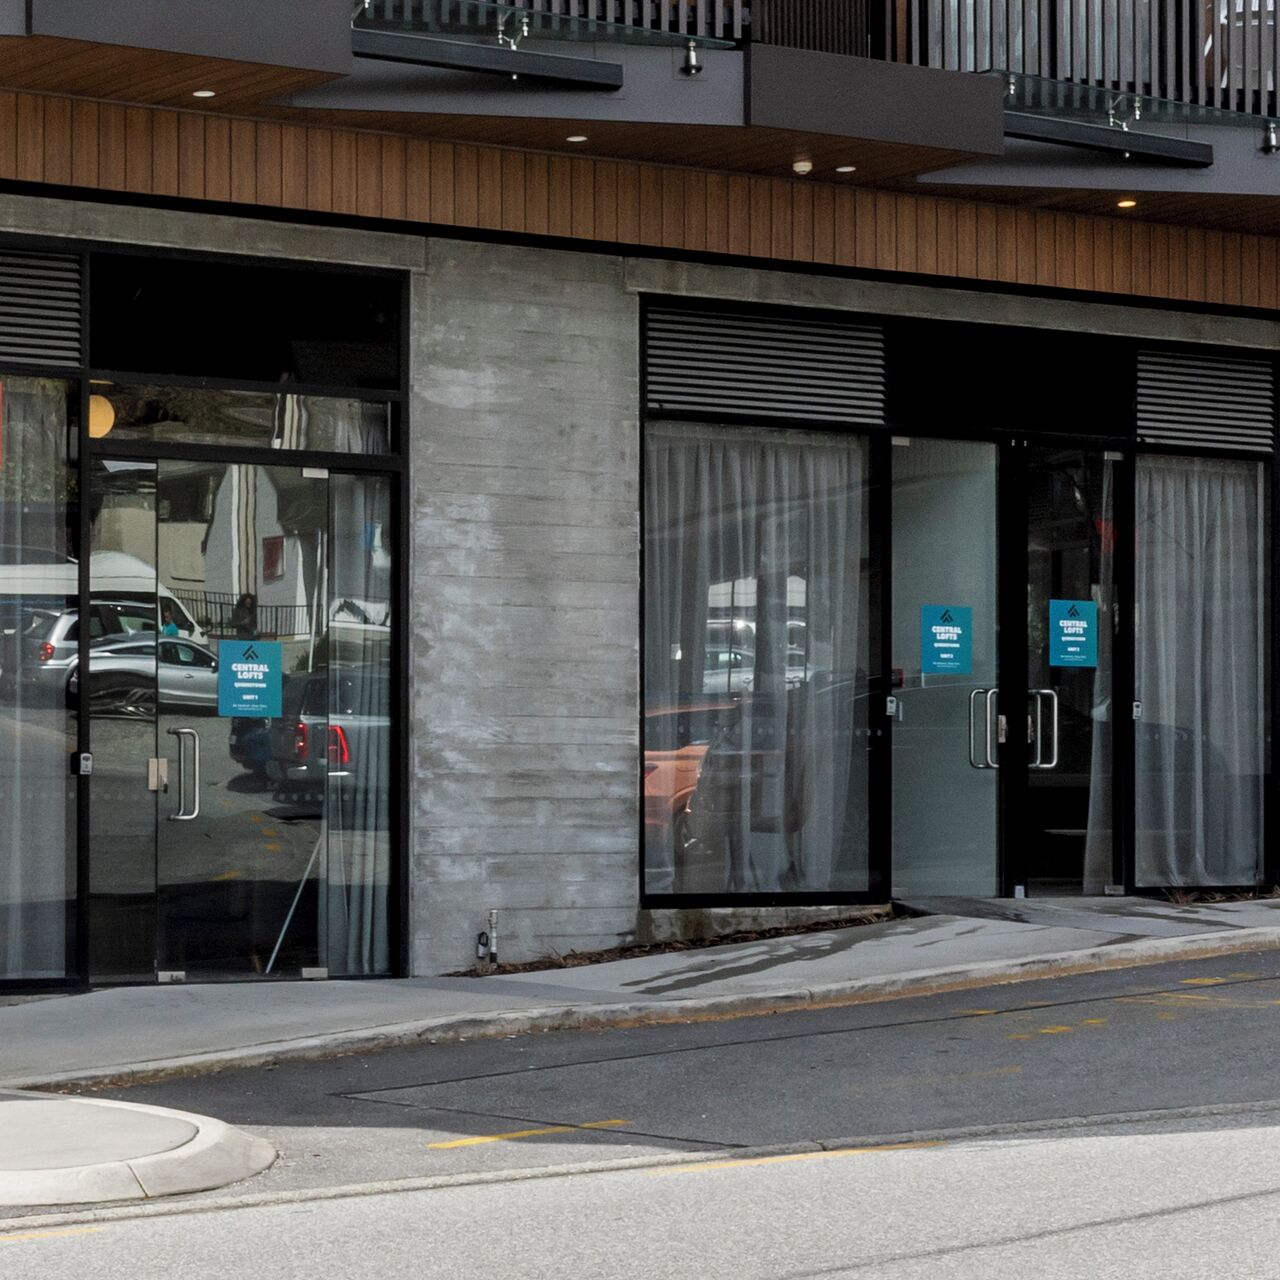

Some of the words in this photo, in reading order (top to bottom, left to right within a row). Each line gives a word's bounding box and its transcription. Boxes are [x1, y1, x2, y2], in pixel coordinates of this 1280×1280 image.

[1058, 620, 1088, 628] CENTRAL
[931, 625, 962, 634] CENTRAL
[231, 663, 270, 673] CENTRAL
[237, 671, 264, 680] LOFTS
